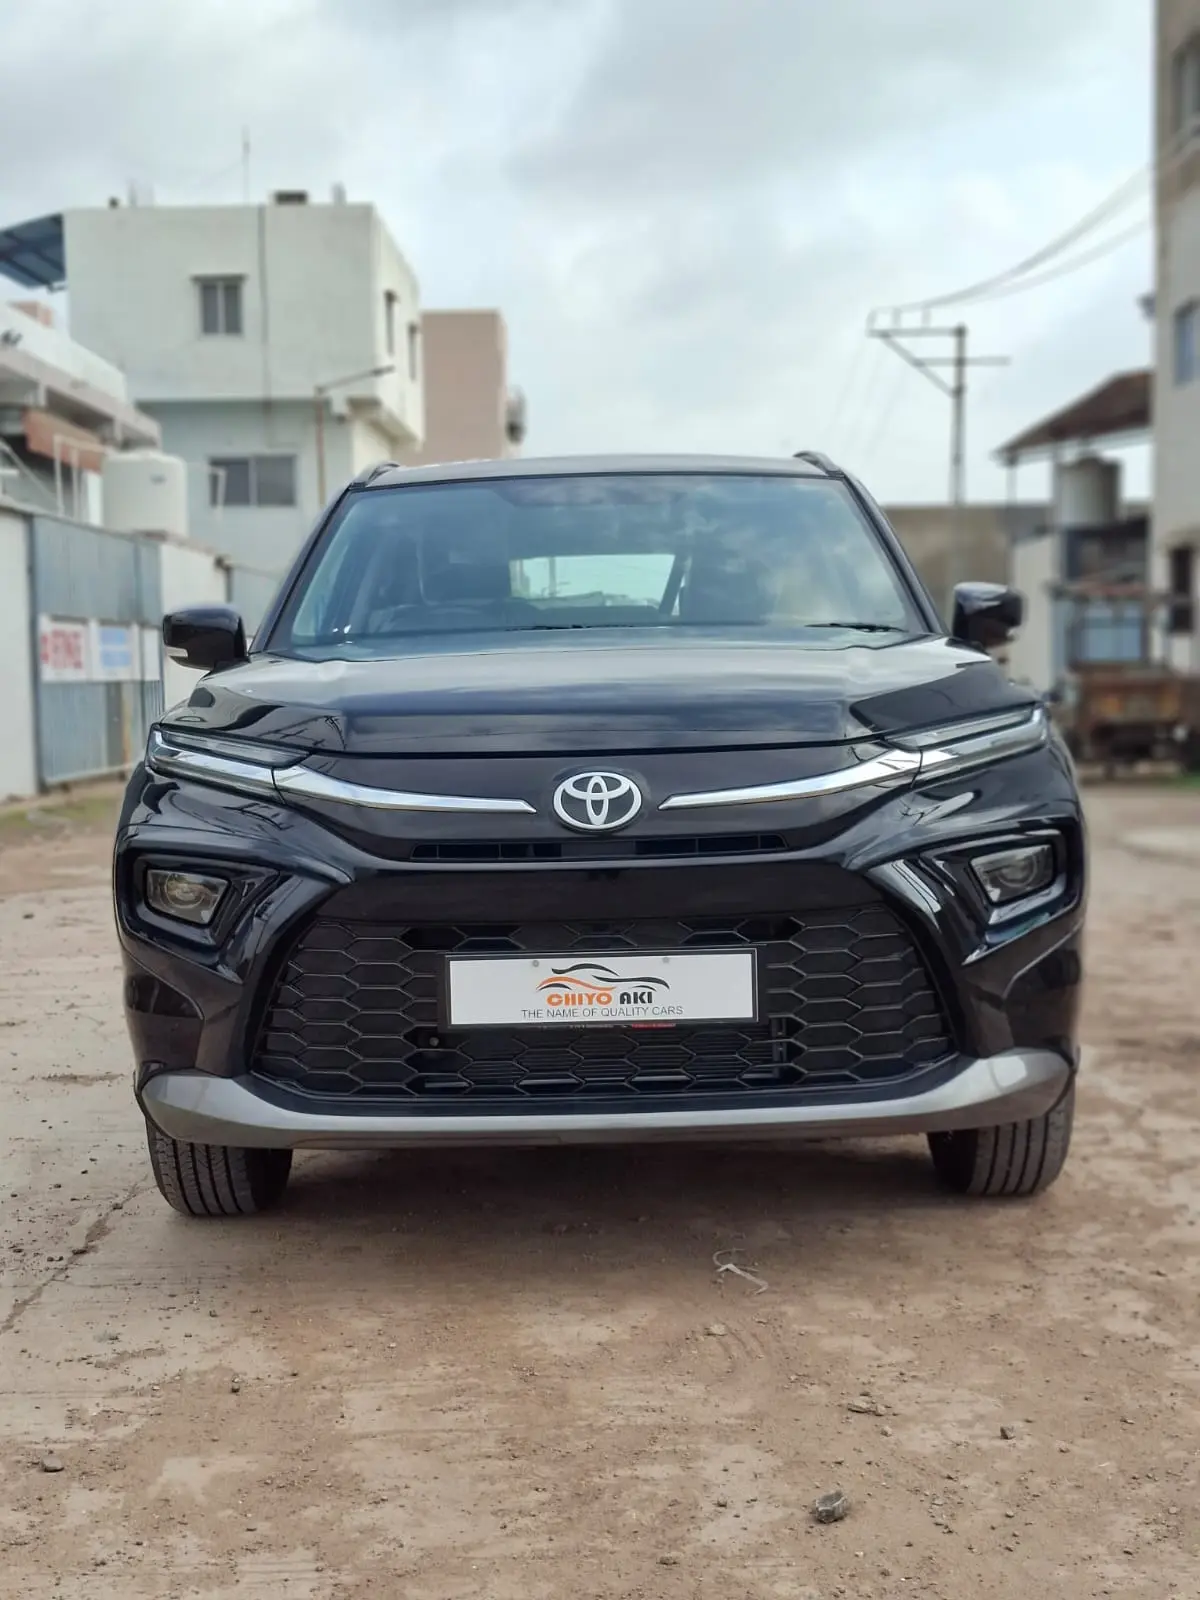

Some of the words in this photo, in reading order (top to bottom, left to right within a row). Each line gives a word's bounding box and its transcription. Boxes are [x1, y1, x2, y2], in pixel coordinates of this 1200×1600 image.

[547, 992, 612, 1006] CHIYO
[619, 991, 652, 1005] AKI
[521, 1009, 544, 1019] THE
[547, 1008, 579, 1018] NAME
[582, 1007, 599, 1018] OF
[601, 1006, 649, 1017] QUALITY
[651, 1005, 684, 1016] CARS
